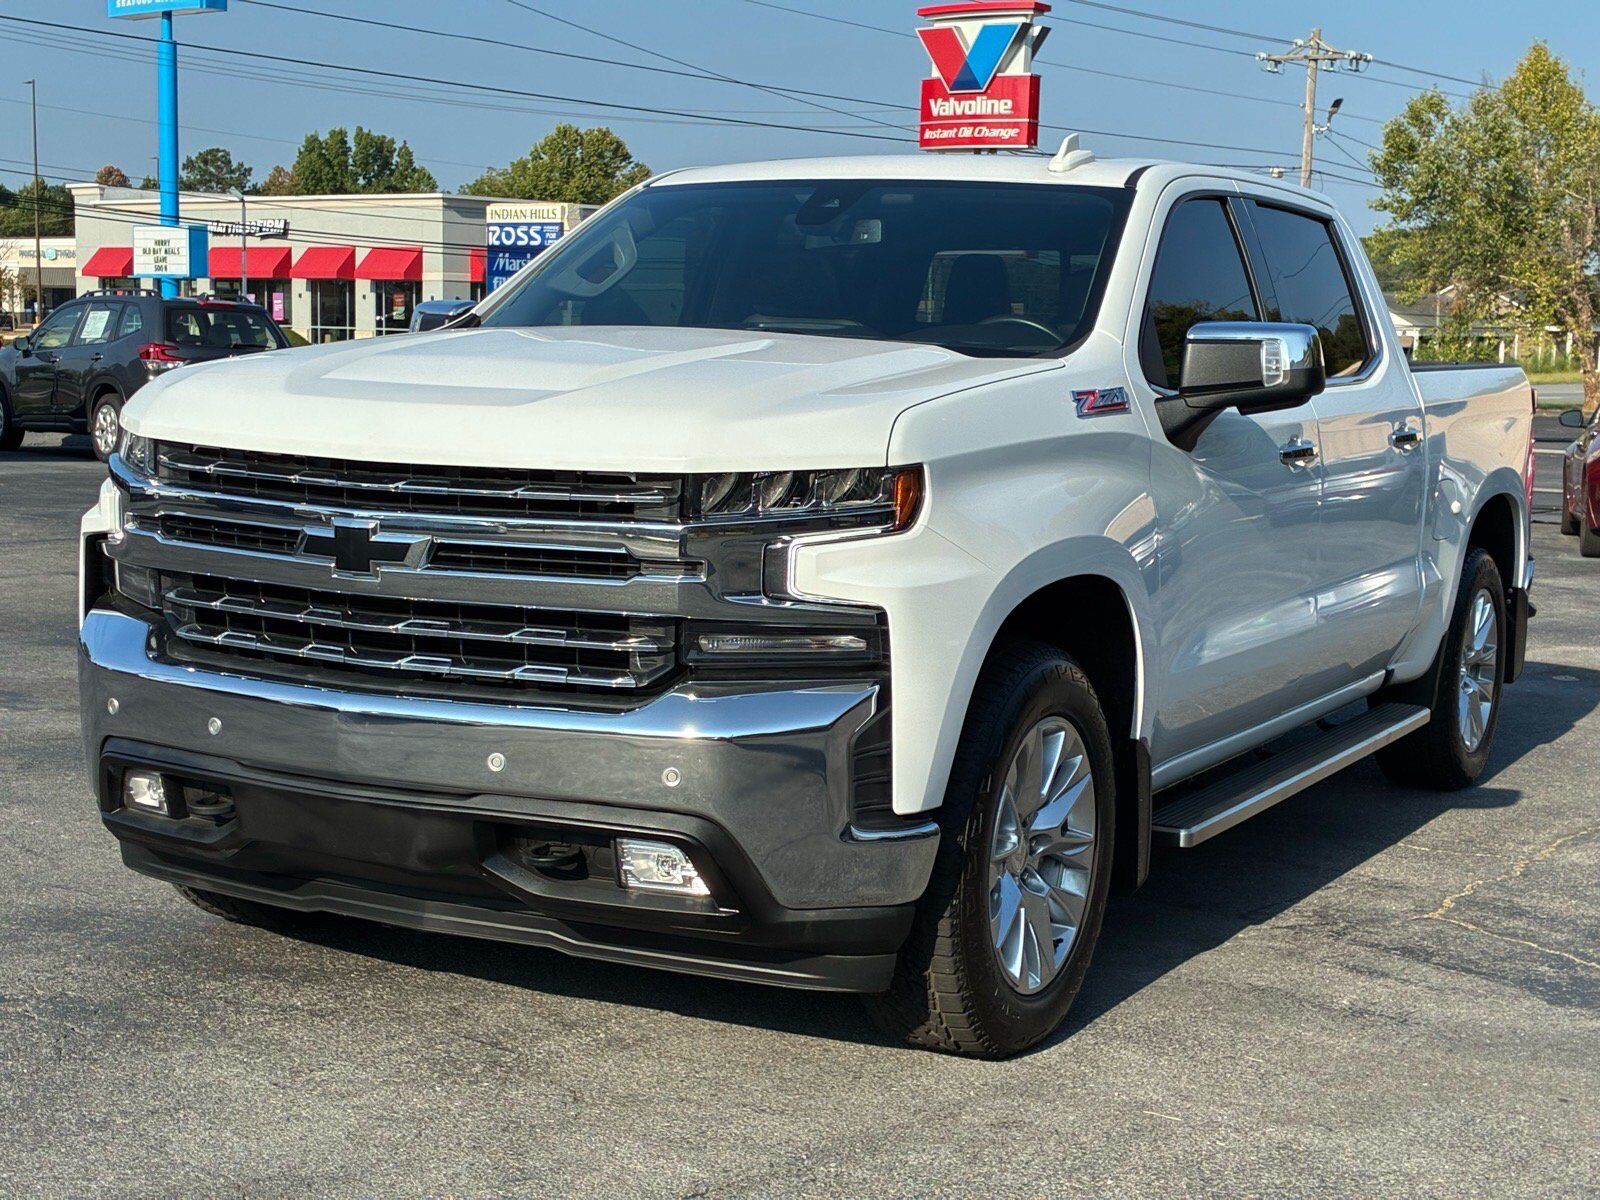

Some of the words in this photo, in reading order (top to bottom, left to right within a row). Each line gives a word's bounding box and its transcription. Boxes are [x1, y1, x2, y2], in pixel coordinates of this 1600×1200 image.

[929, 96, 1013, 116] Valvoline
[924, 127, 958, 139] Instant
[958, 126, 974, 138] Oil
[974, 126, 1020, 139] Change
[490, 208, 527, 220] INDIAN
[530, 208, 557, 220] HILLS
[488, 225, 542, 246] ROSS
[153, 256, 168, 264] LEAVE
